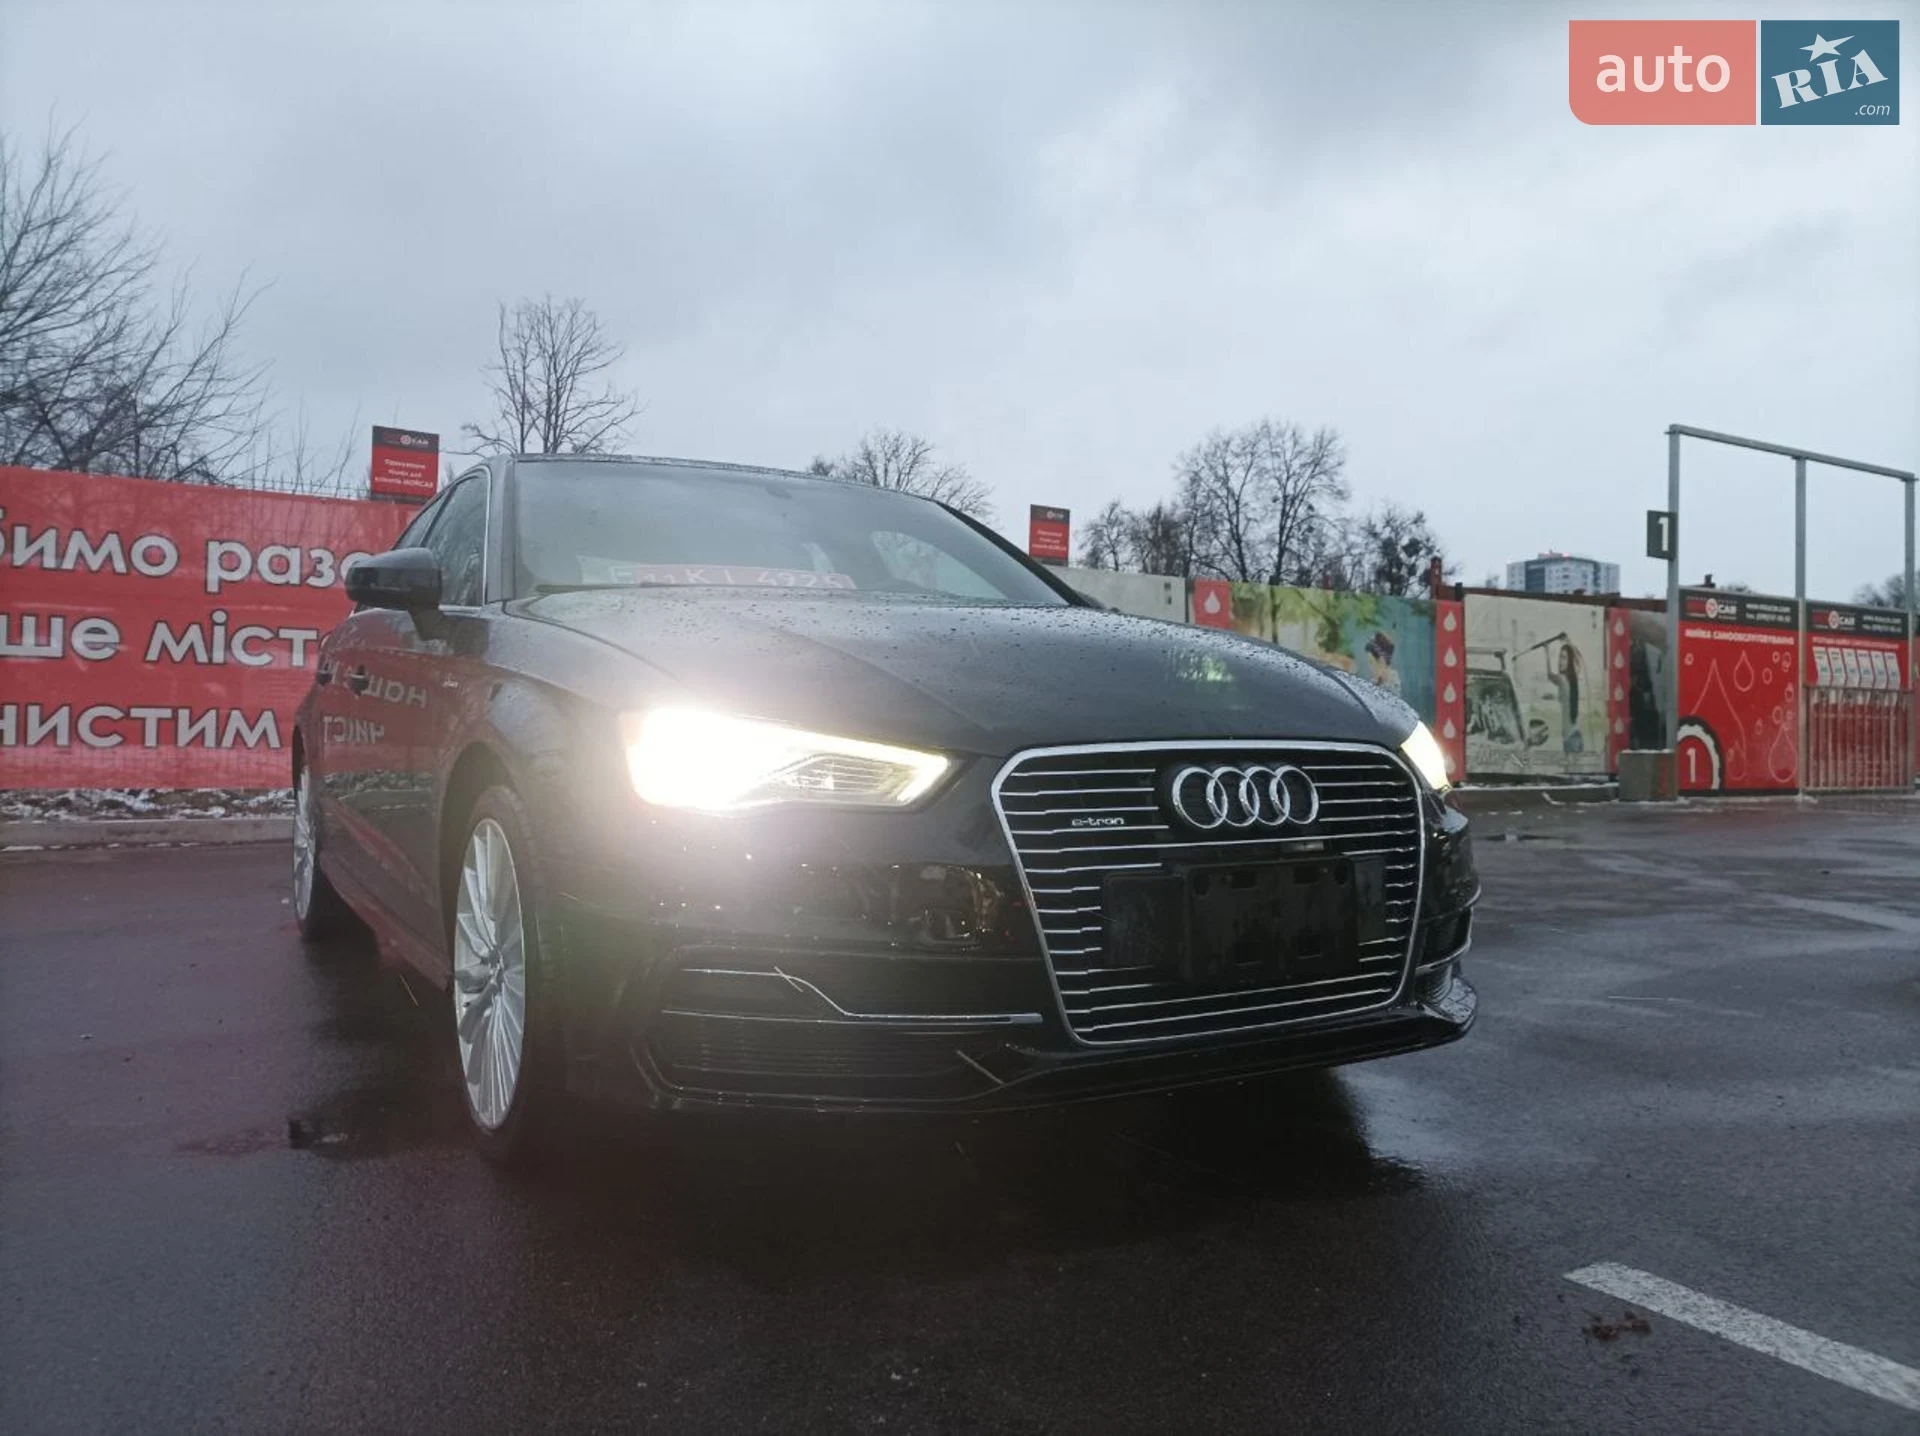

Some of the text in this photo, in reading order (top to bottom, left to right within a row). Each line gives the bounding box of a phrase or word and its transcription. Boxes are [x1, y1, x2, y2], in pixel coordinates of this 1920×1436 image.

[0, 508, 178, 577] имо
[1658, 516, 1669, 551] 1
[144, 610, 331, 667] міст
[1685, 747, 1696, 783] 1
[1071, 817, 1125, 827] e-tron
